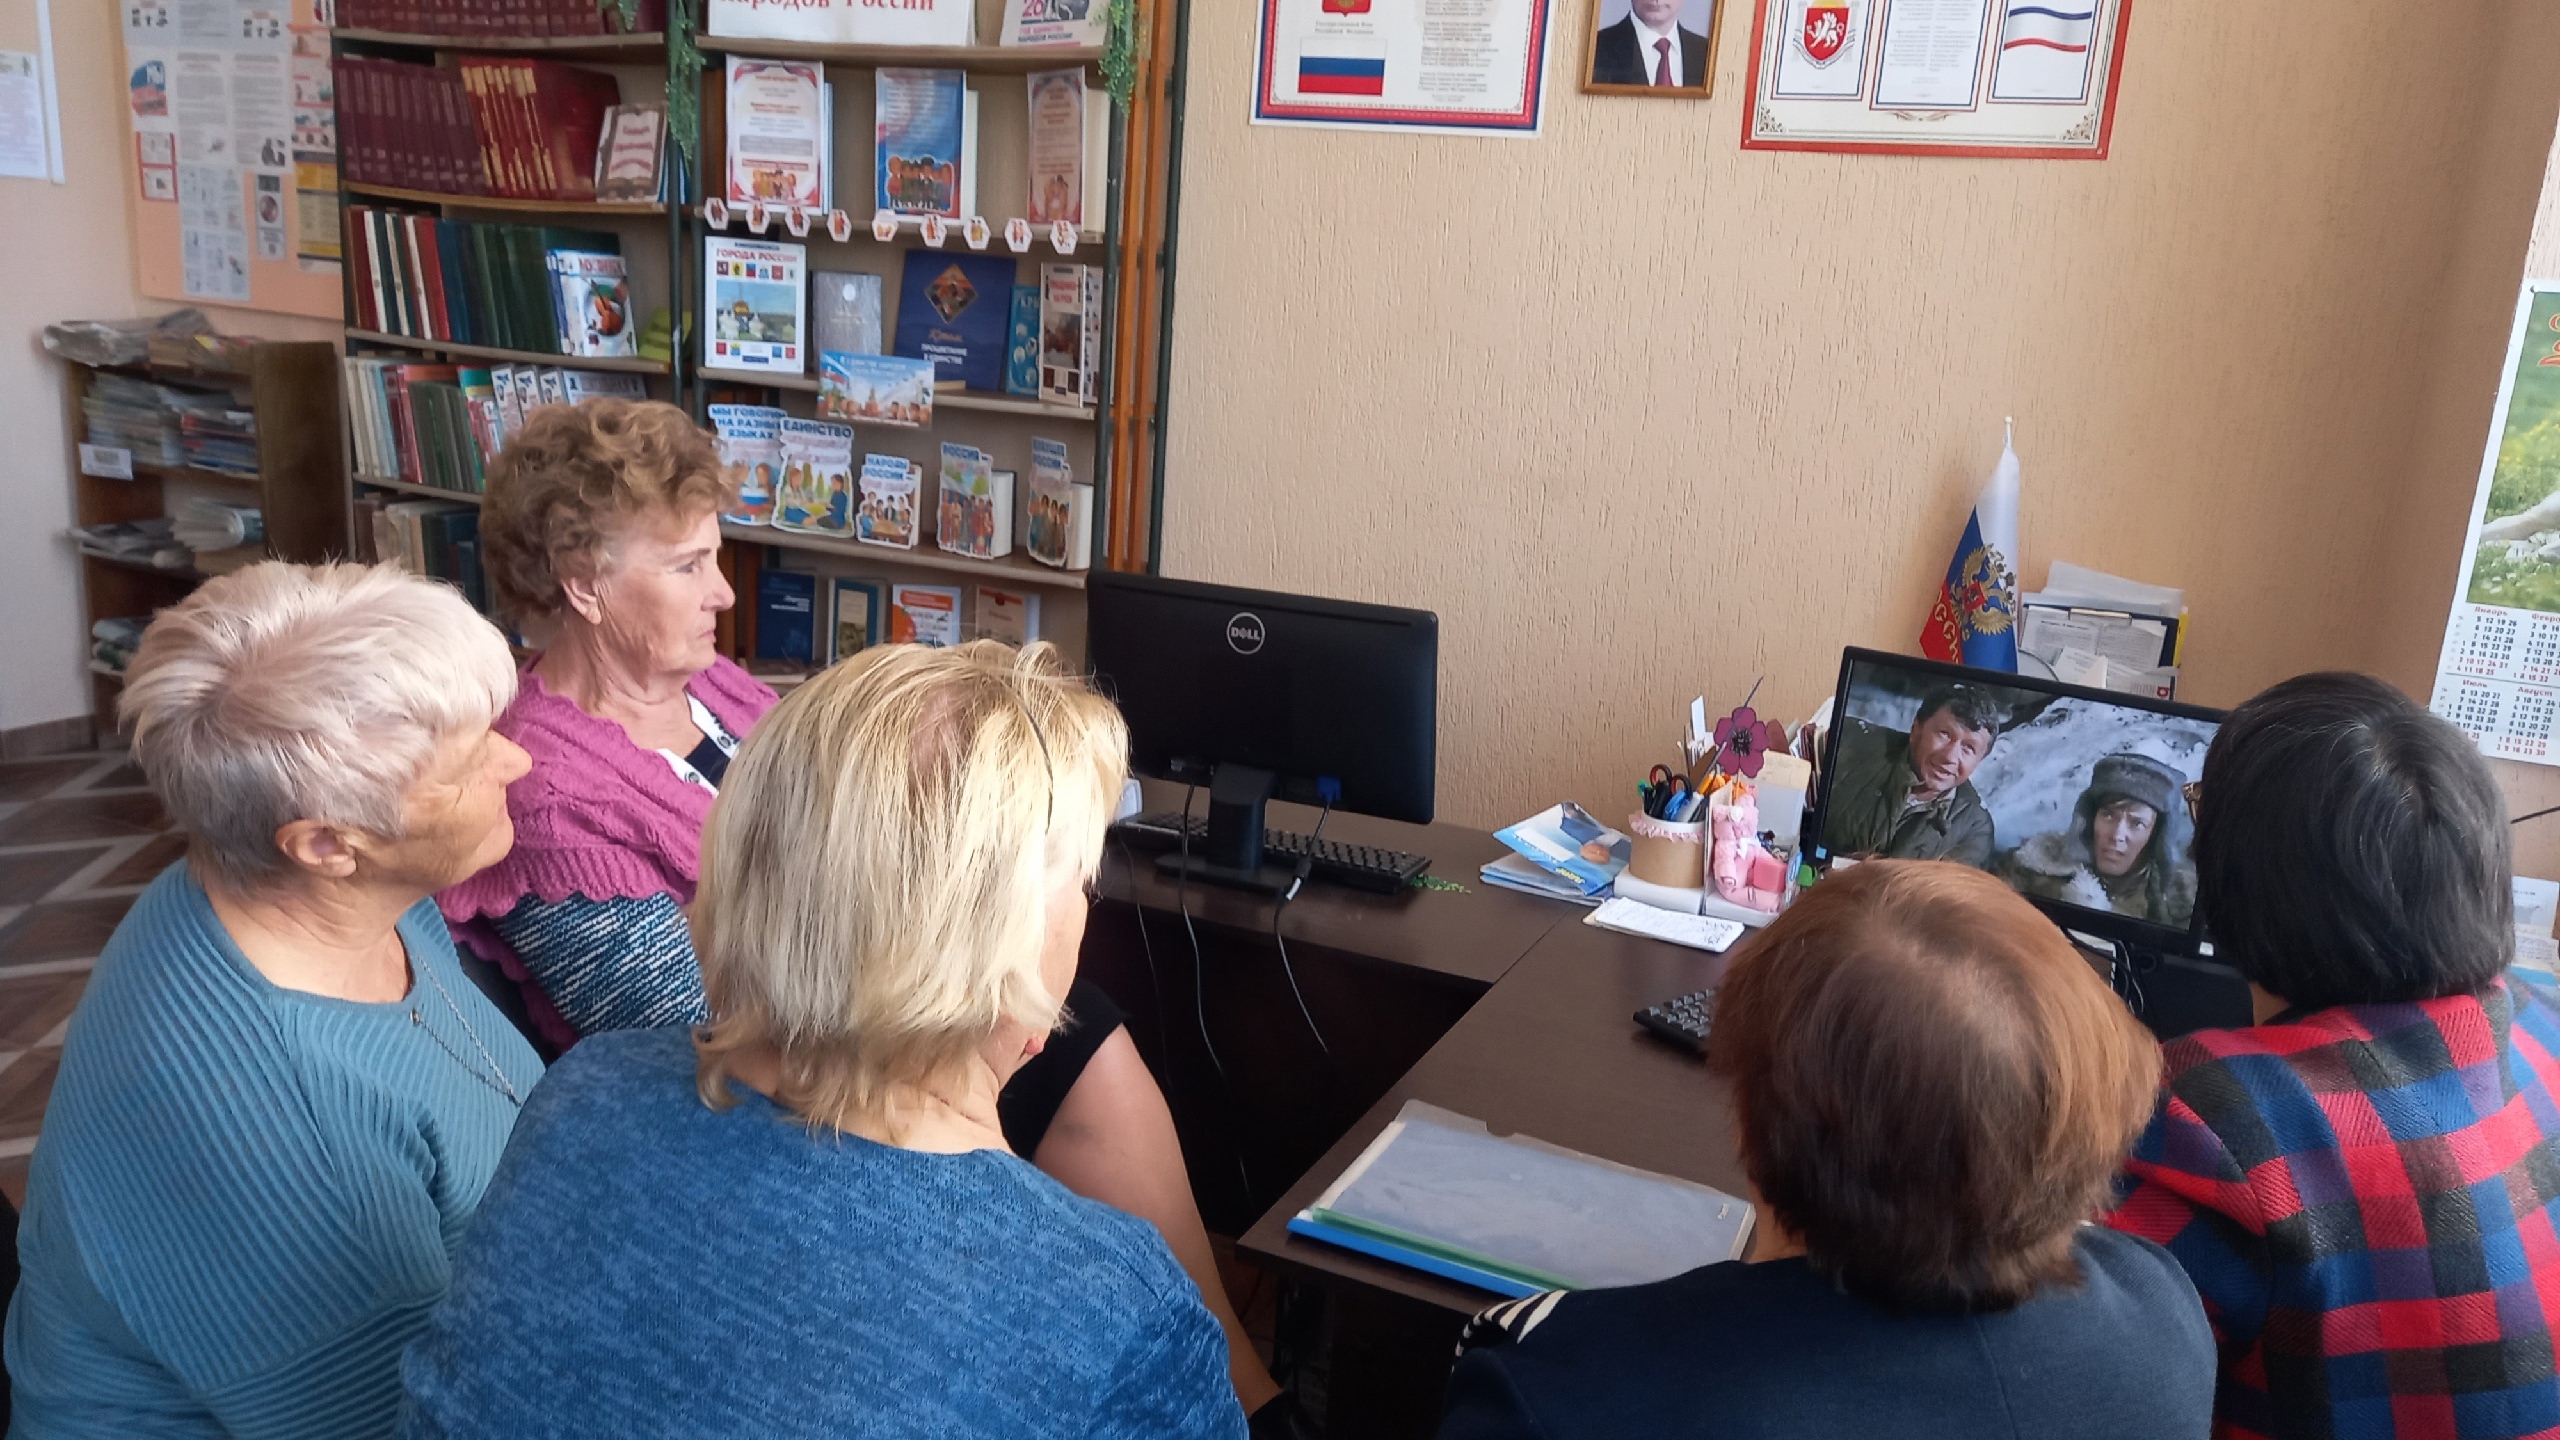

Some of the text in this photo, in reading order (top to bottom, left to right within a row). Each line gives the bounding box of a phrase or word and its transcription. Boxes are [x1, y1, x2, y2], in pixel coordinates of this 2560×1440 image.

[737, 419, 780, 429] РАЗНЫ
[783, 420, 851, 438] ЕДИНСТВО
[943, 444, 979, 461] РОССИЯ
[2475, 606, 2508, 616] Январь
[1231, 627, 1260, 641] DELL
[2518, 686, 2552, 696] Август
